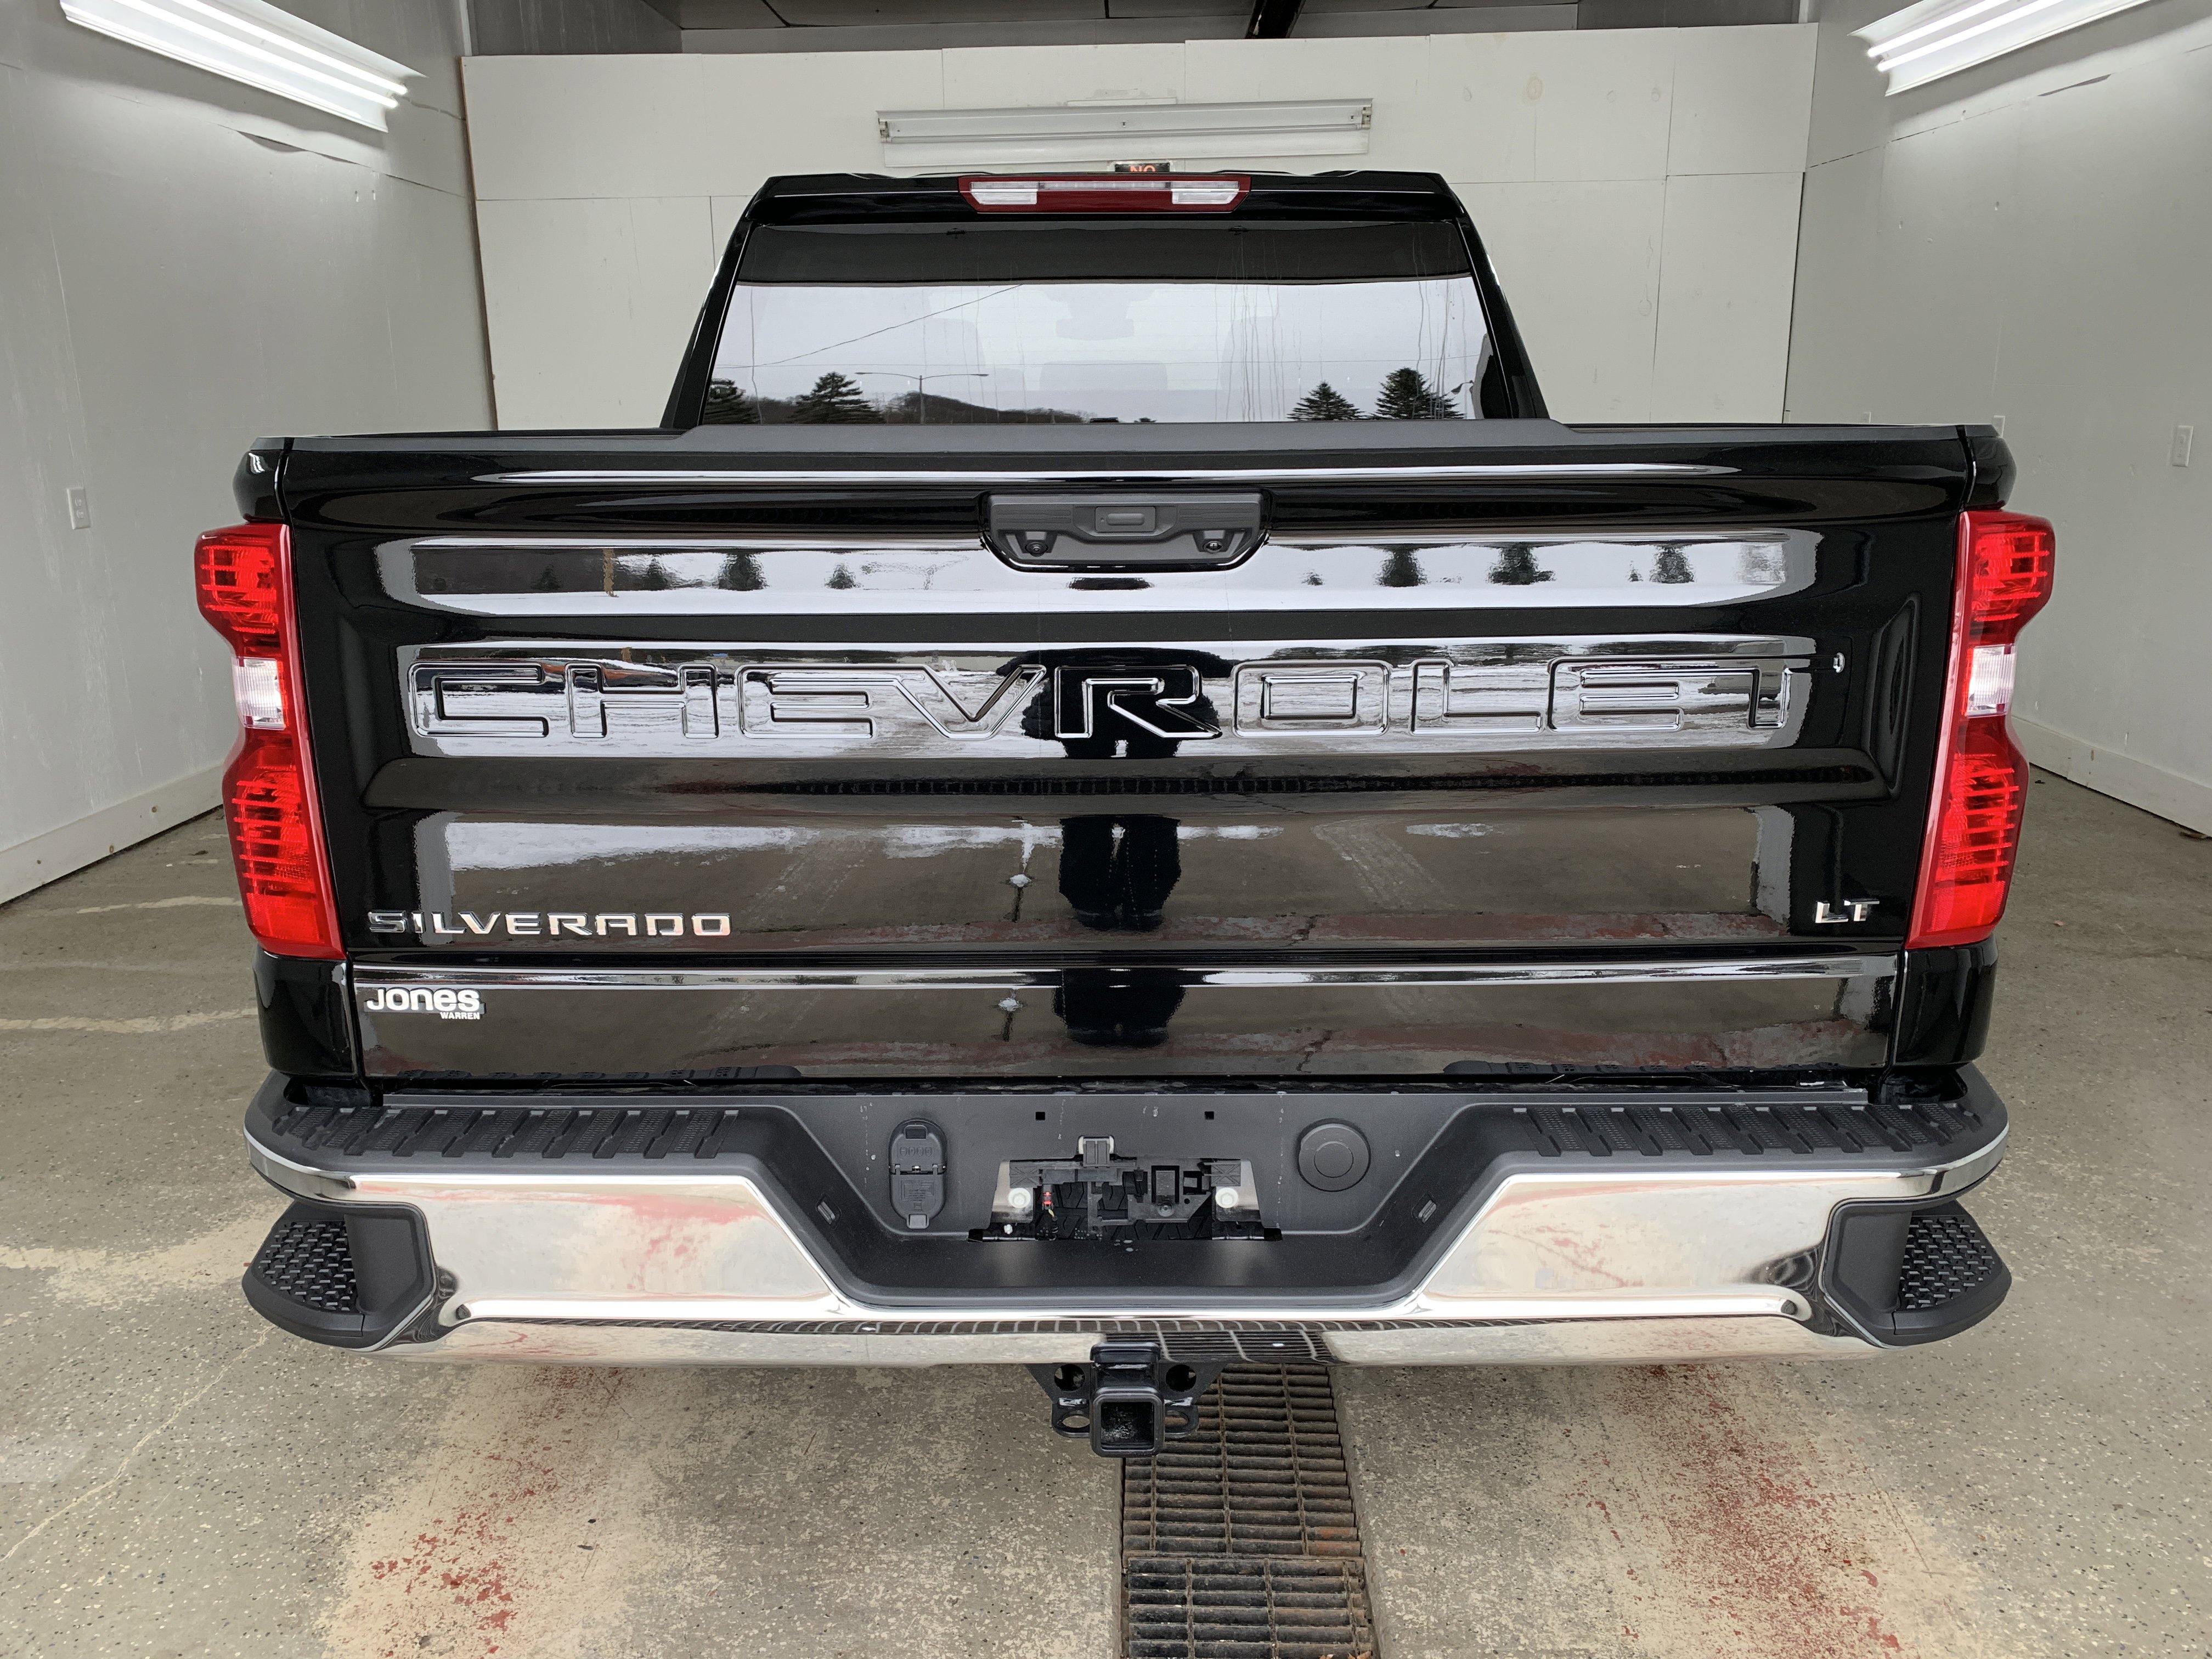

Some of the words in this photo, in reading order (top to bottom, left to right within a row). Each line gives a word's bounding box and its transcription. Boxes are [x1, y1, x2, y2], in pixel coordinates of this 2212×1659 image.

[410, 654, 1845, 739] CHEVROLET
[368, 910, 732, 936] SILVERADO
[1815, 898, 1880, 923] LT
[439, 1012, 481, 1020] WARREN
